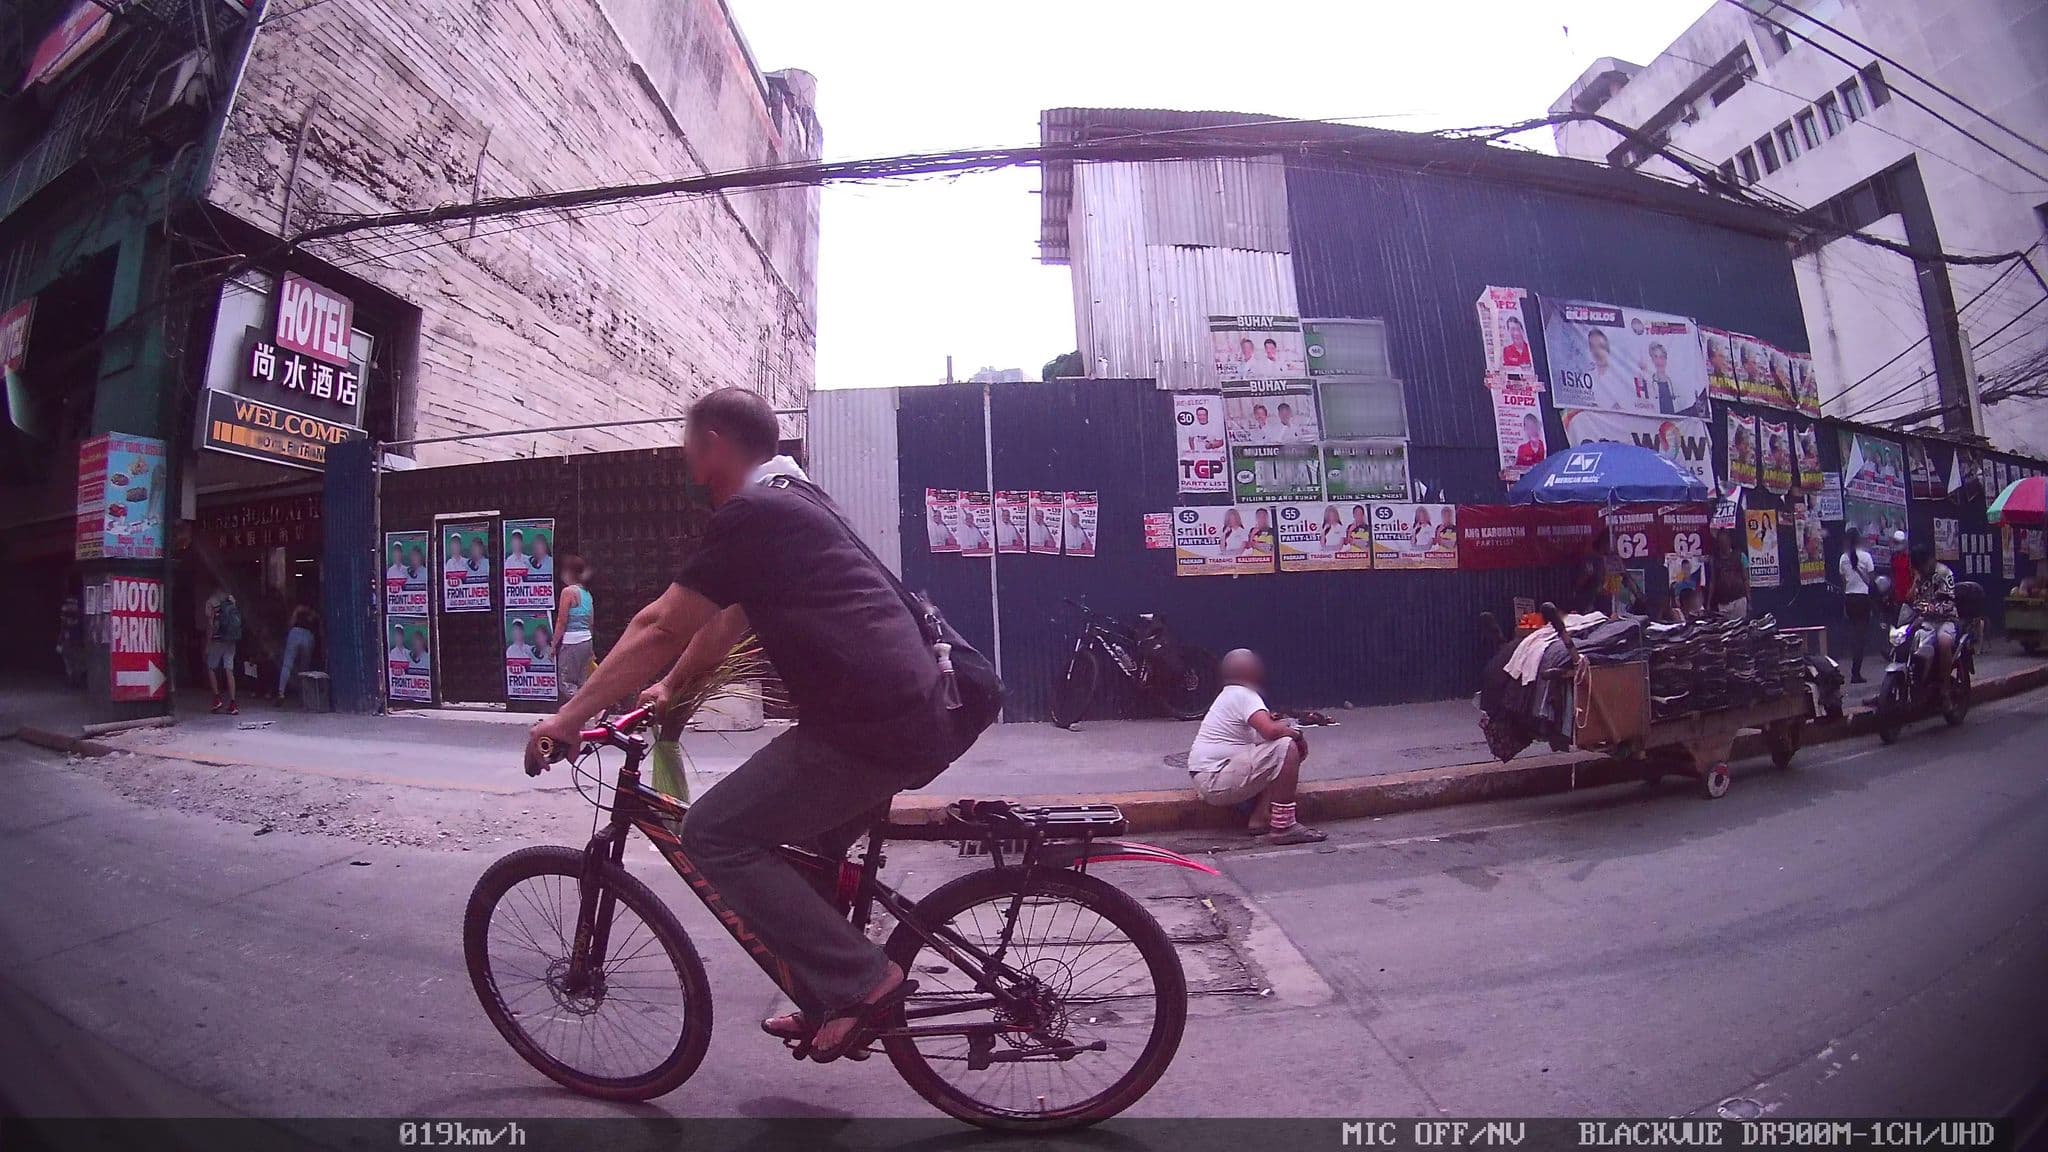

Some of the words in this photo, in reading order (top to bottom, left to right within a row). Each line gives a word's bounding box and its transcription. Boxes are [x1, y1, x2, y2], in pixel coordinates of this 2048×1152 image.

[278, 279, 350, 361] HOTEL
[1236, 316, 1275, 327] BUHAY
[1589, 311, 1615, 322] KILOS
[252, 341, 358, 406] 尚水酒店
[1560, 369, 1593, 390] ISKO
[1249, 380, 1288, 393] BUHAY
[1503, 395, 1536, 407] LOPEZ
[234, 400, 350, 444] WELCOME
[1179, 412, 1193, 423] 30
[1180, 460, 1223, 479] TGP
[1183, 512, 1194, 522] 55
[1285, 509, 1296, 519] 55
[1379, 508, 1389, 519] 55
[1177, 523, 1217, 537] smile
[1280, 520, 1318, 533] smile
[1374, 519, 1409, 532] smile
[1464, 528, 1480, 538] ANG
[1178, 538, 1221, 546] PARTY-LIST
[1475, 538, 1514, 547] PARTYLIST
[1617, 532, 1649, 559] 62
[1674, 533, 1703, 556] 62
[1751, 552, 1775, 565] smile
[447, 586, 489, 599] FRONTLINERS
[506, 585, 552, 597] FRONTLINERS
[388, 594, 427, 605] FRONTLINERS
[391, 676, 429, 689] FRONTLINERS
[508, 675, 556, 687] FRONTLINERS
